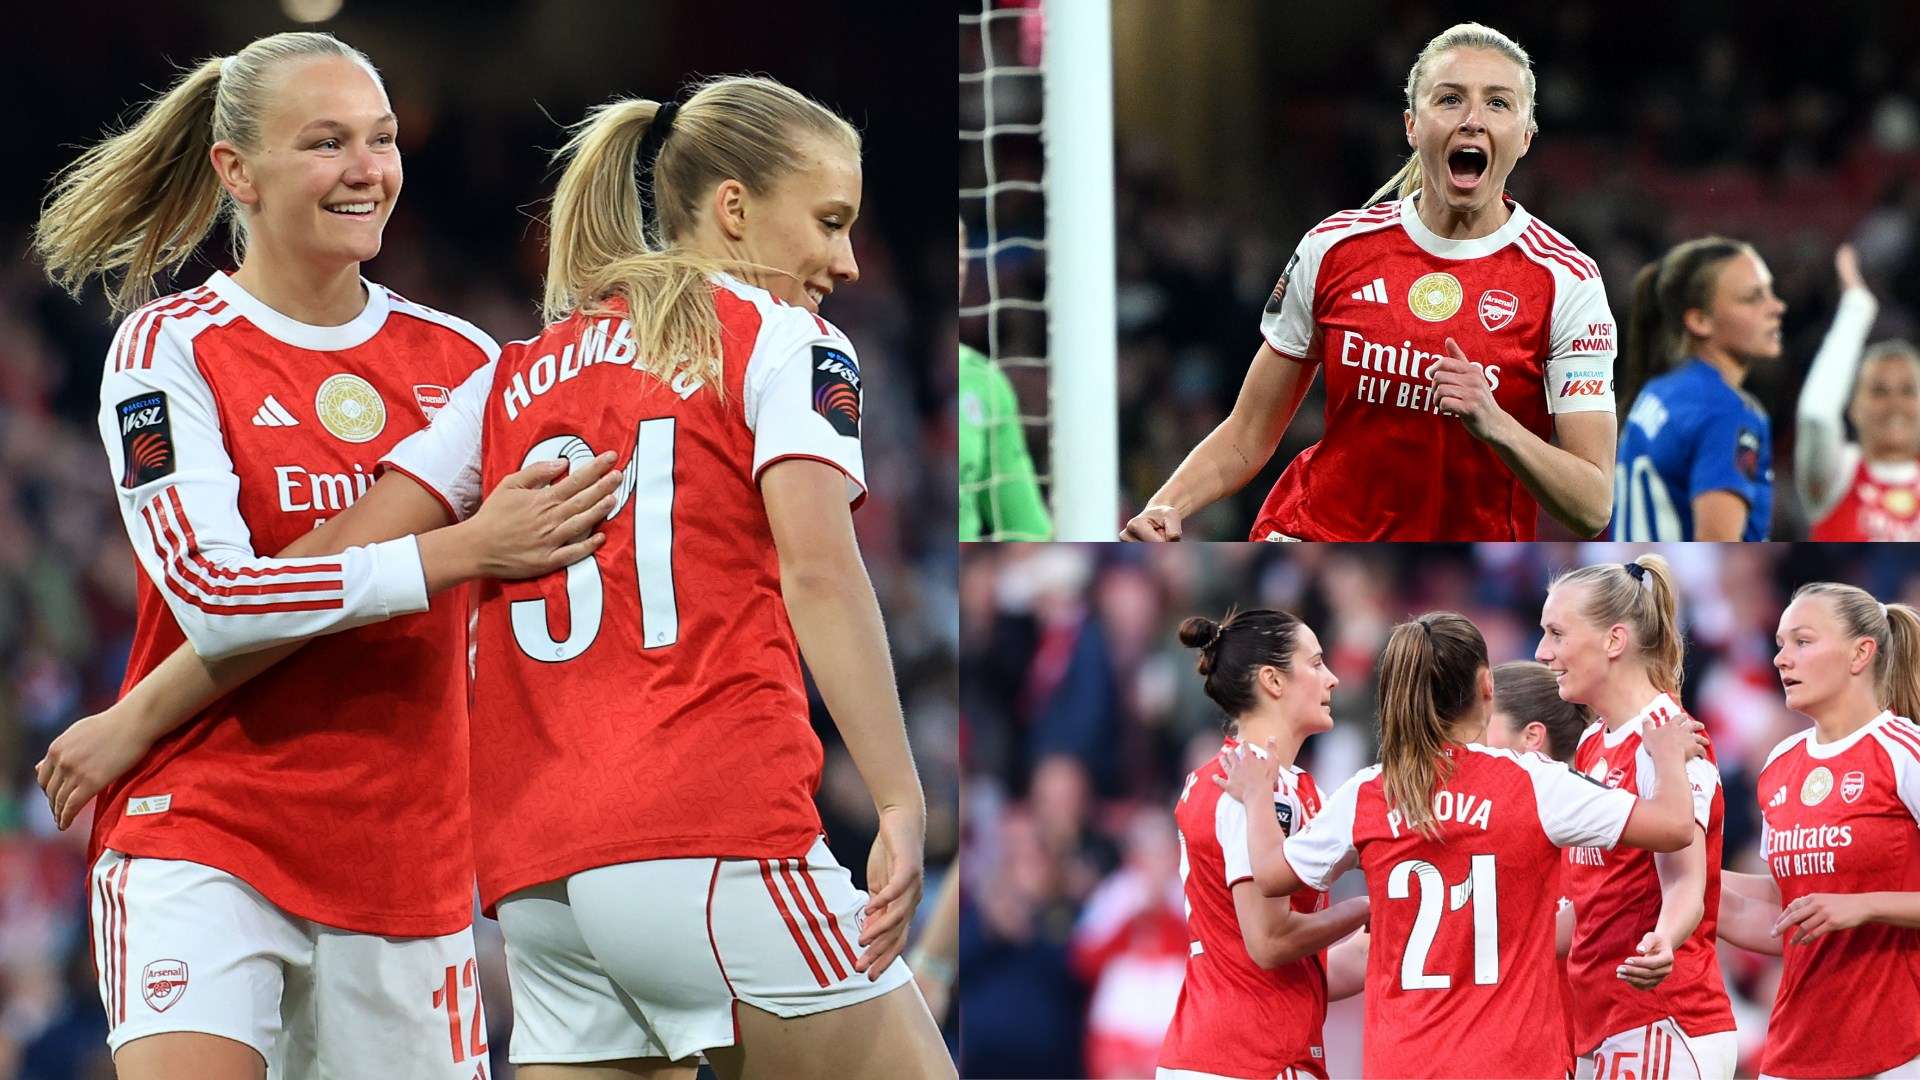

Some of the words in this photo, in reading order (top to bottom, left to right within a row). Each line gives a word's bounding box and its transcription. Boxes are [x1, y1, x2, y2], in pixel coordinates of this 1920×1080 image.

[1486, 295, 1513, 308] Arsenal
[503, 319, 706, 422] HOLMBG
[817, 358, 860, 391] WSL
[1341, 330, 1501, 393] Emiras
[1357, 375, 1391, 404] FLY
[1396, 382, 1461, 418] BET
[1560, 379, 1605, 397] WSL
[122, 406, 165, 437] WSL
[1386, 790, 1493, 839] POVA
[1767, 824, 1853, 855] Emirates
[1774, 855, 1791, 879] FLY
[1794, 851, 1835, 876] BETTER
[1387, 853, 1500, 992] 21
[147, 967, 182, 978] Arsenal
[432, 957, 487, 1064] 12
